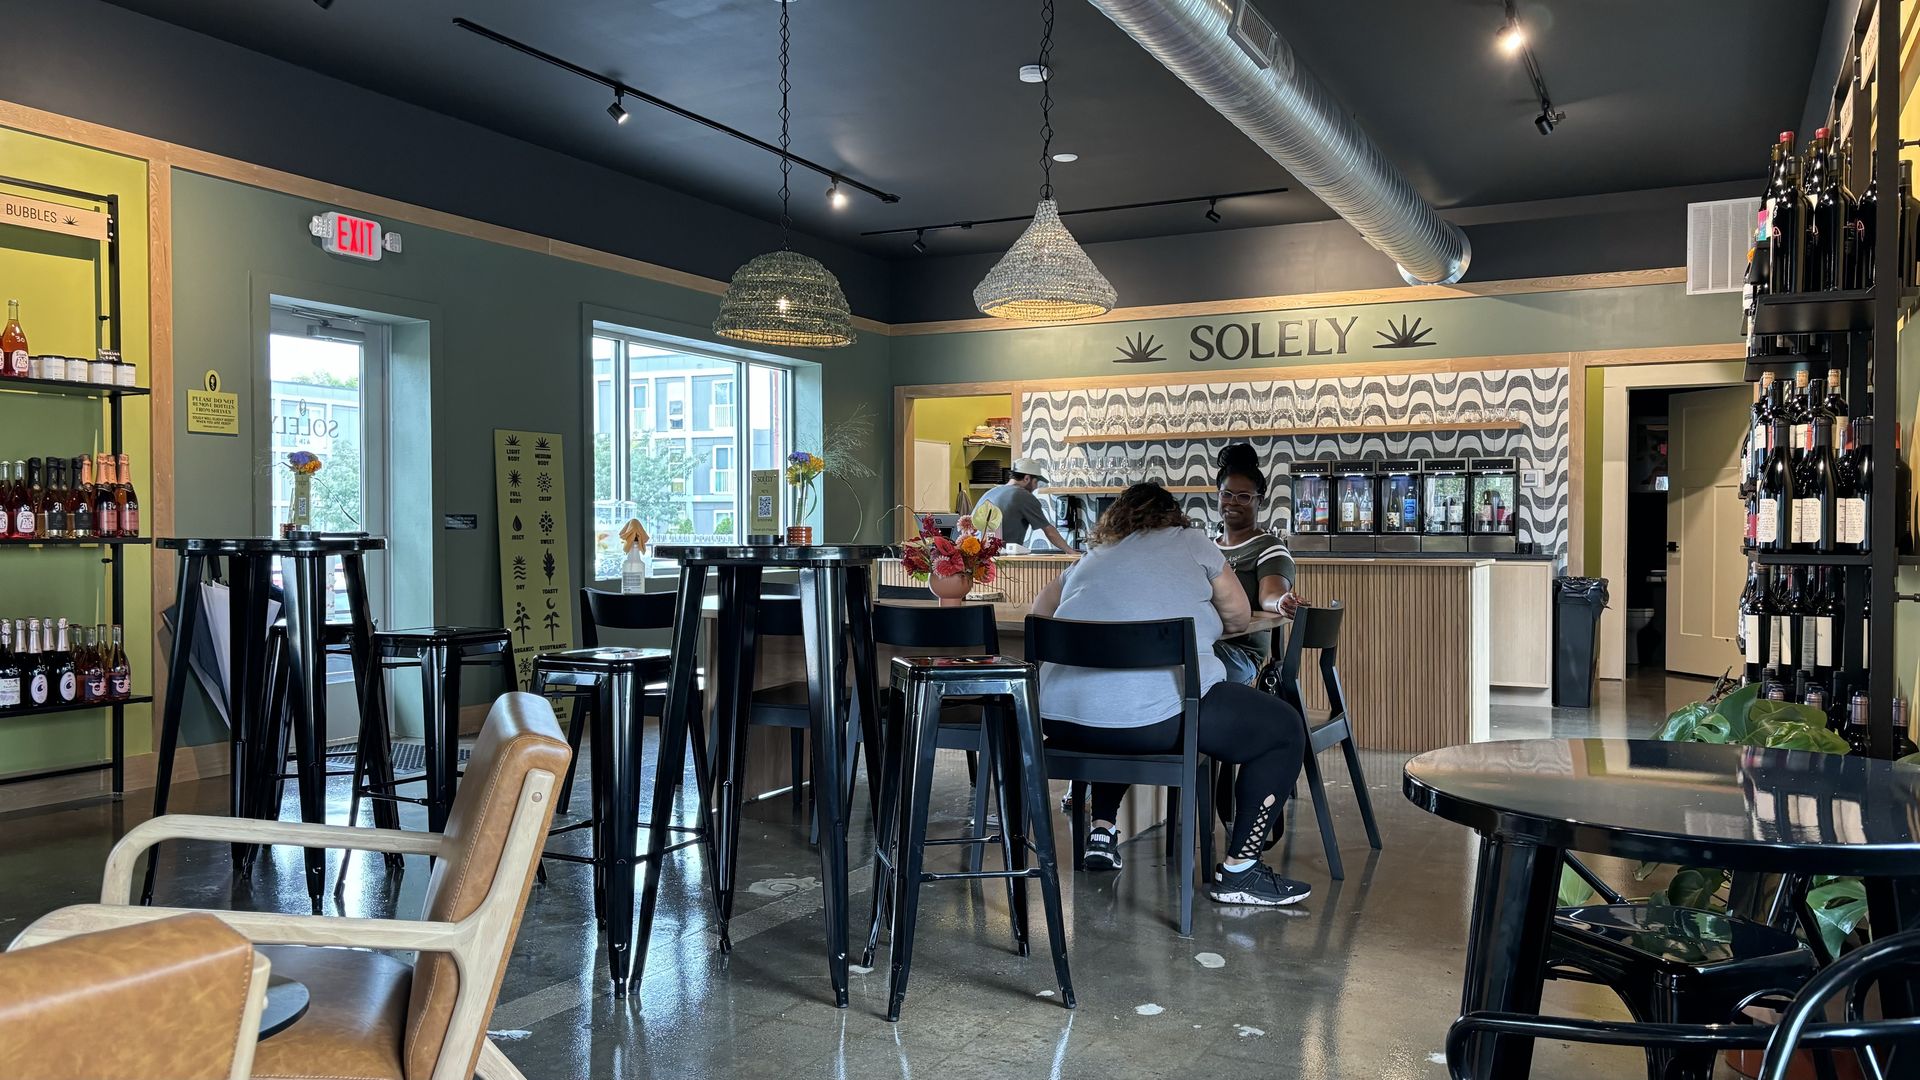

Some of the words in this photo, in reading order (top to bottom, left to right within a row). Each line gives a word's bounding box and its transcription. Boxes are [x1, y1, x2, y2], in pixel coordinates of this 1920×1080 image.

[6, 203, 57, 224] BUBBLES
[337, 215, 375, 256] EXIT
[1189, 316, 1358, 361] SOLELY
[514, 646, 535, 654] ORGANIC
[539, 643, 568, 651] BIODYNAMIC
[1090, 834, 1110, 843] PUMA
